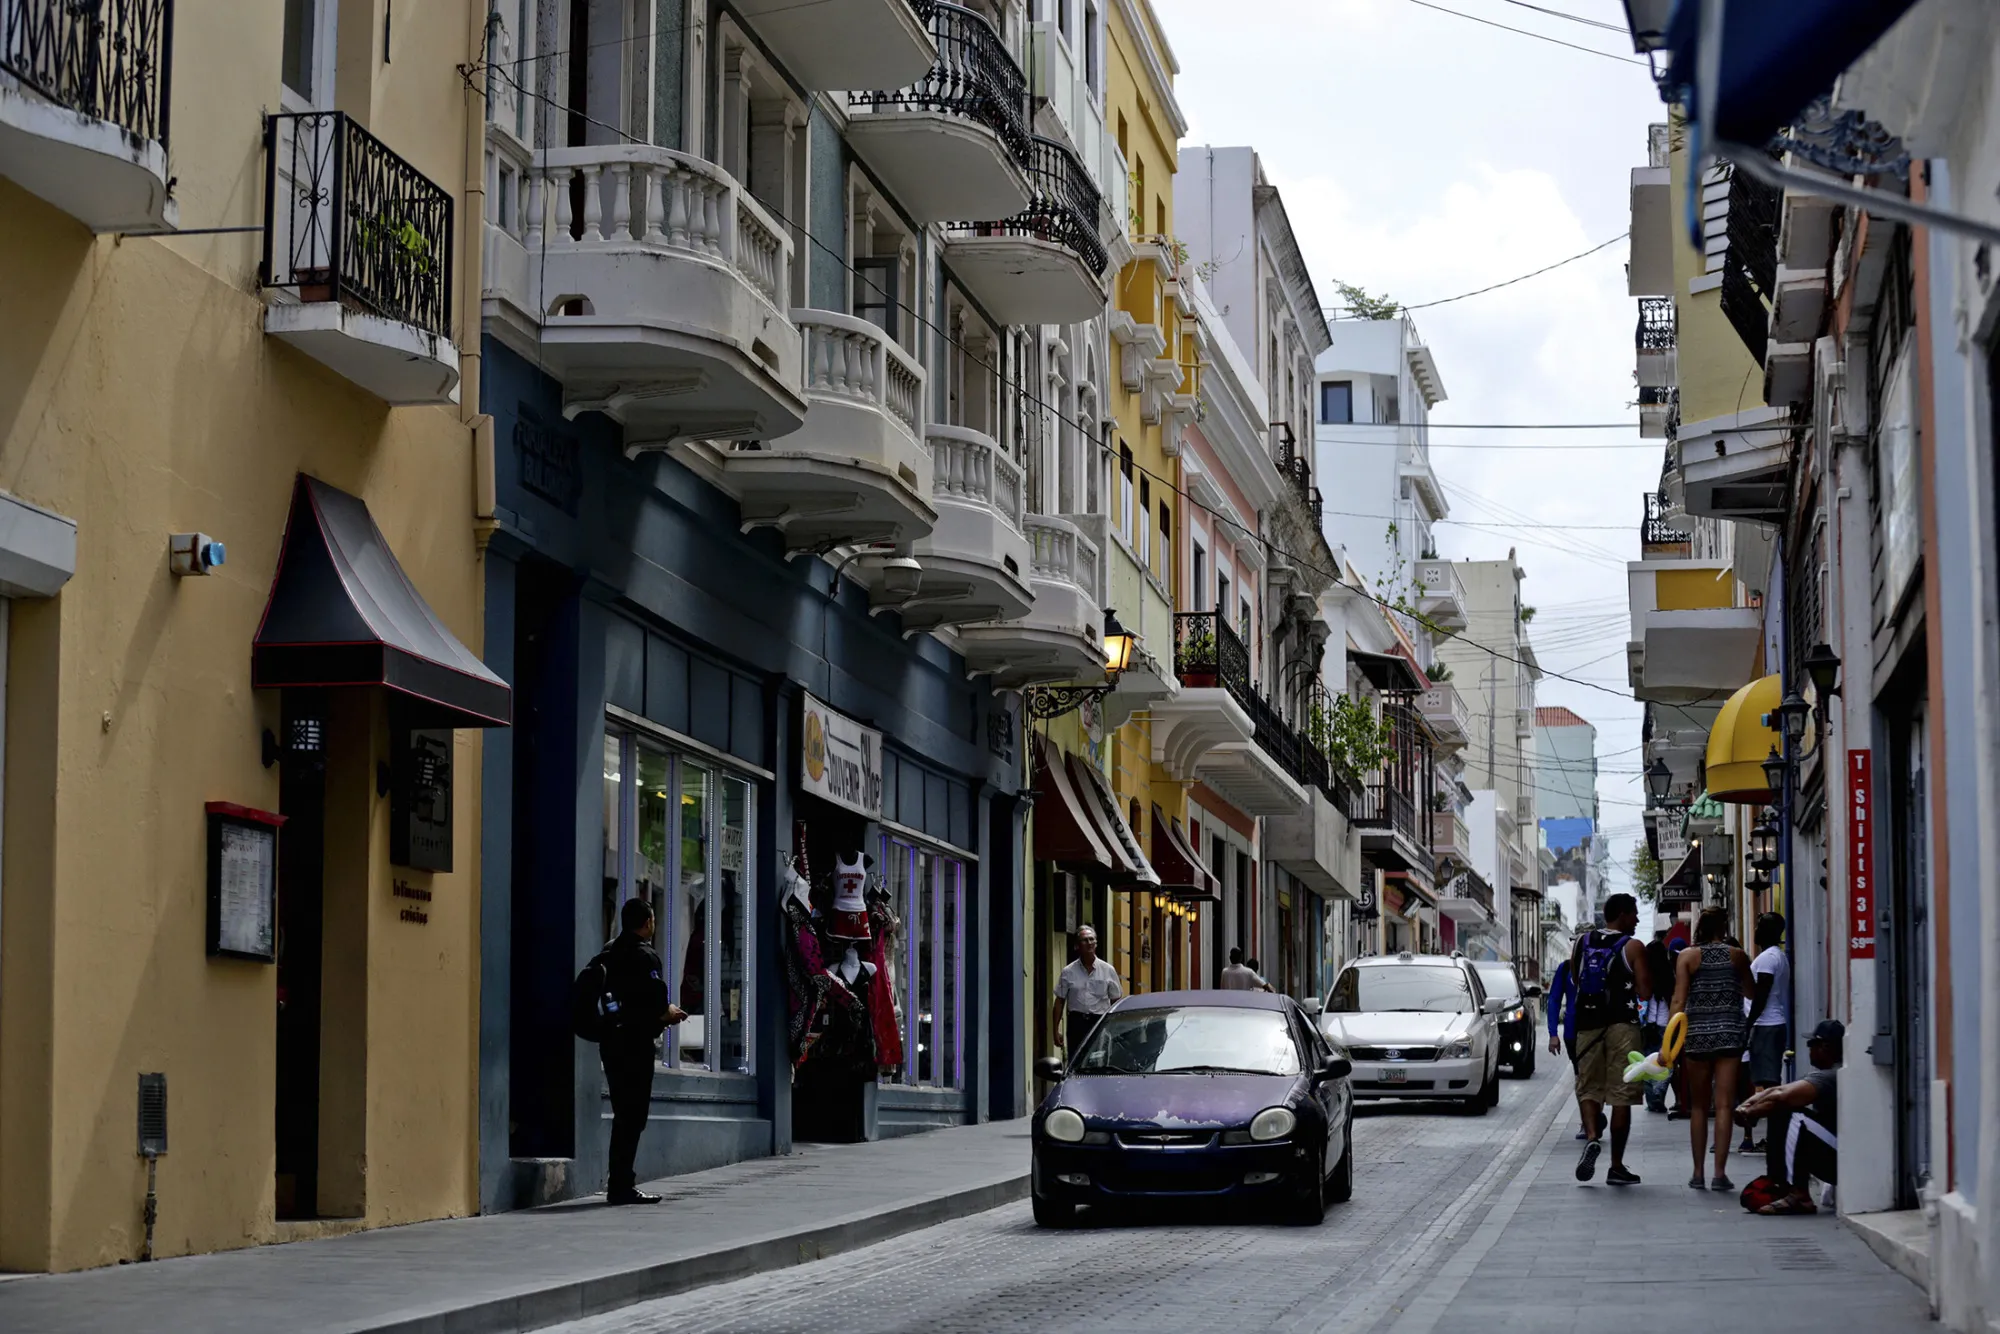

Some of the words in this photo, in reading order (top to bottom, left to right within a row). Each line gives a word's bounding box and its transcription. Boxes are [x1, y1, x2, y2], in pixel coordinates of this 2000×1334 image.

[824, 714, 861, 806] SOUVENIR
[860, 732, 880, 812] SHOP
[1664, 888, 1678, 897] Gifts
[400, 904, 428, 924] cuisine
